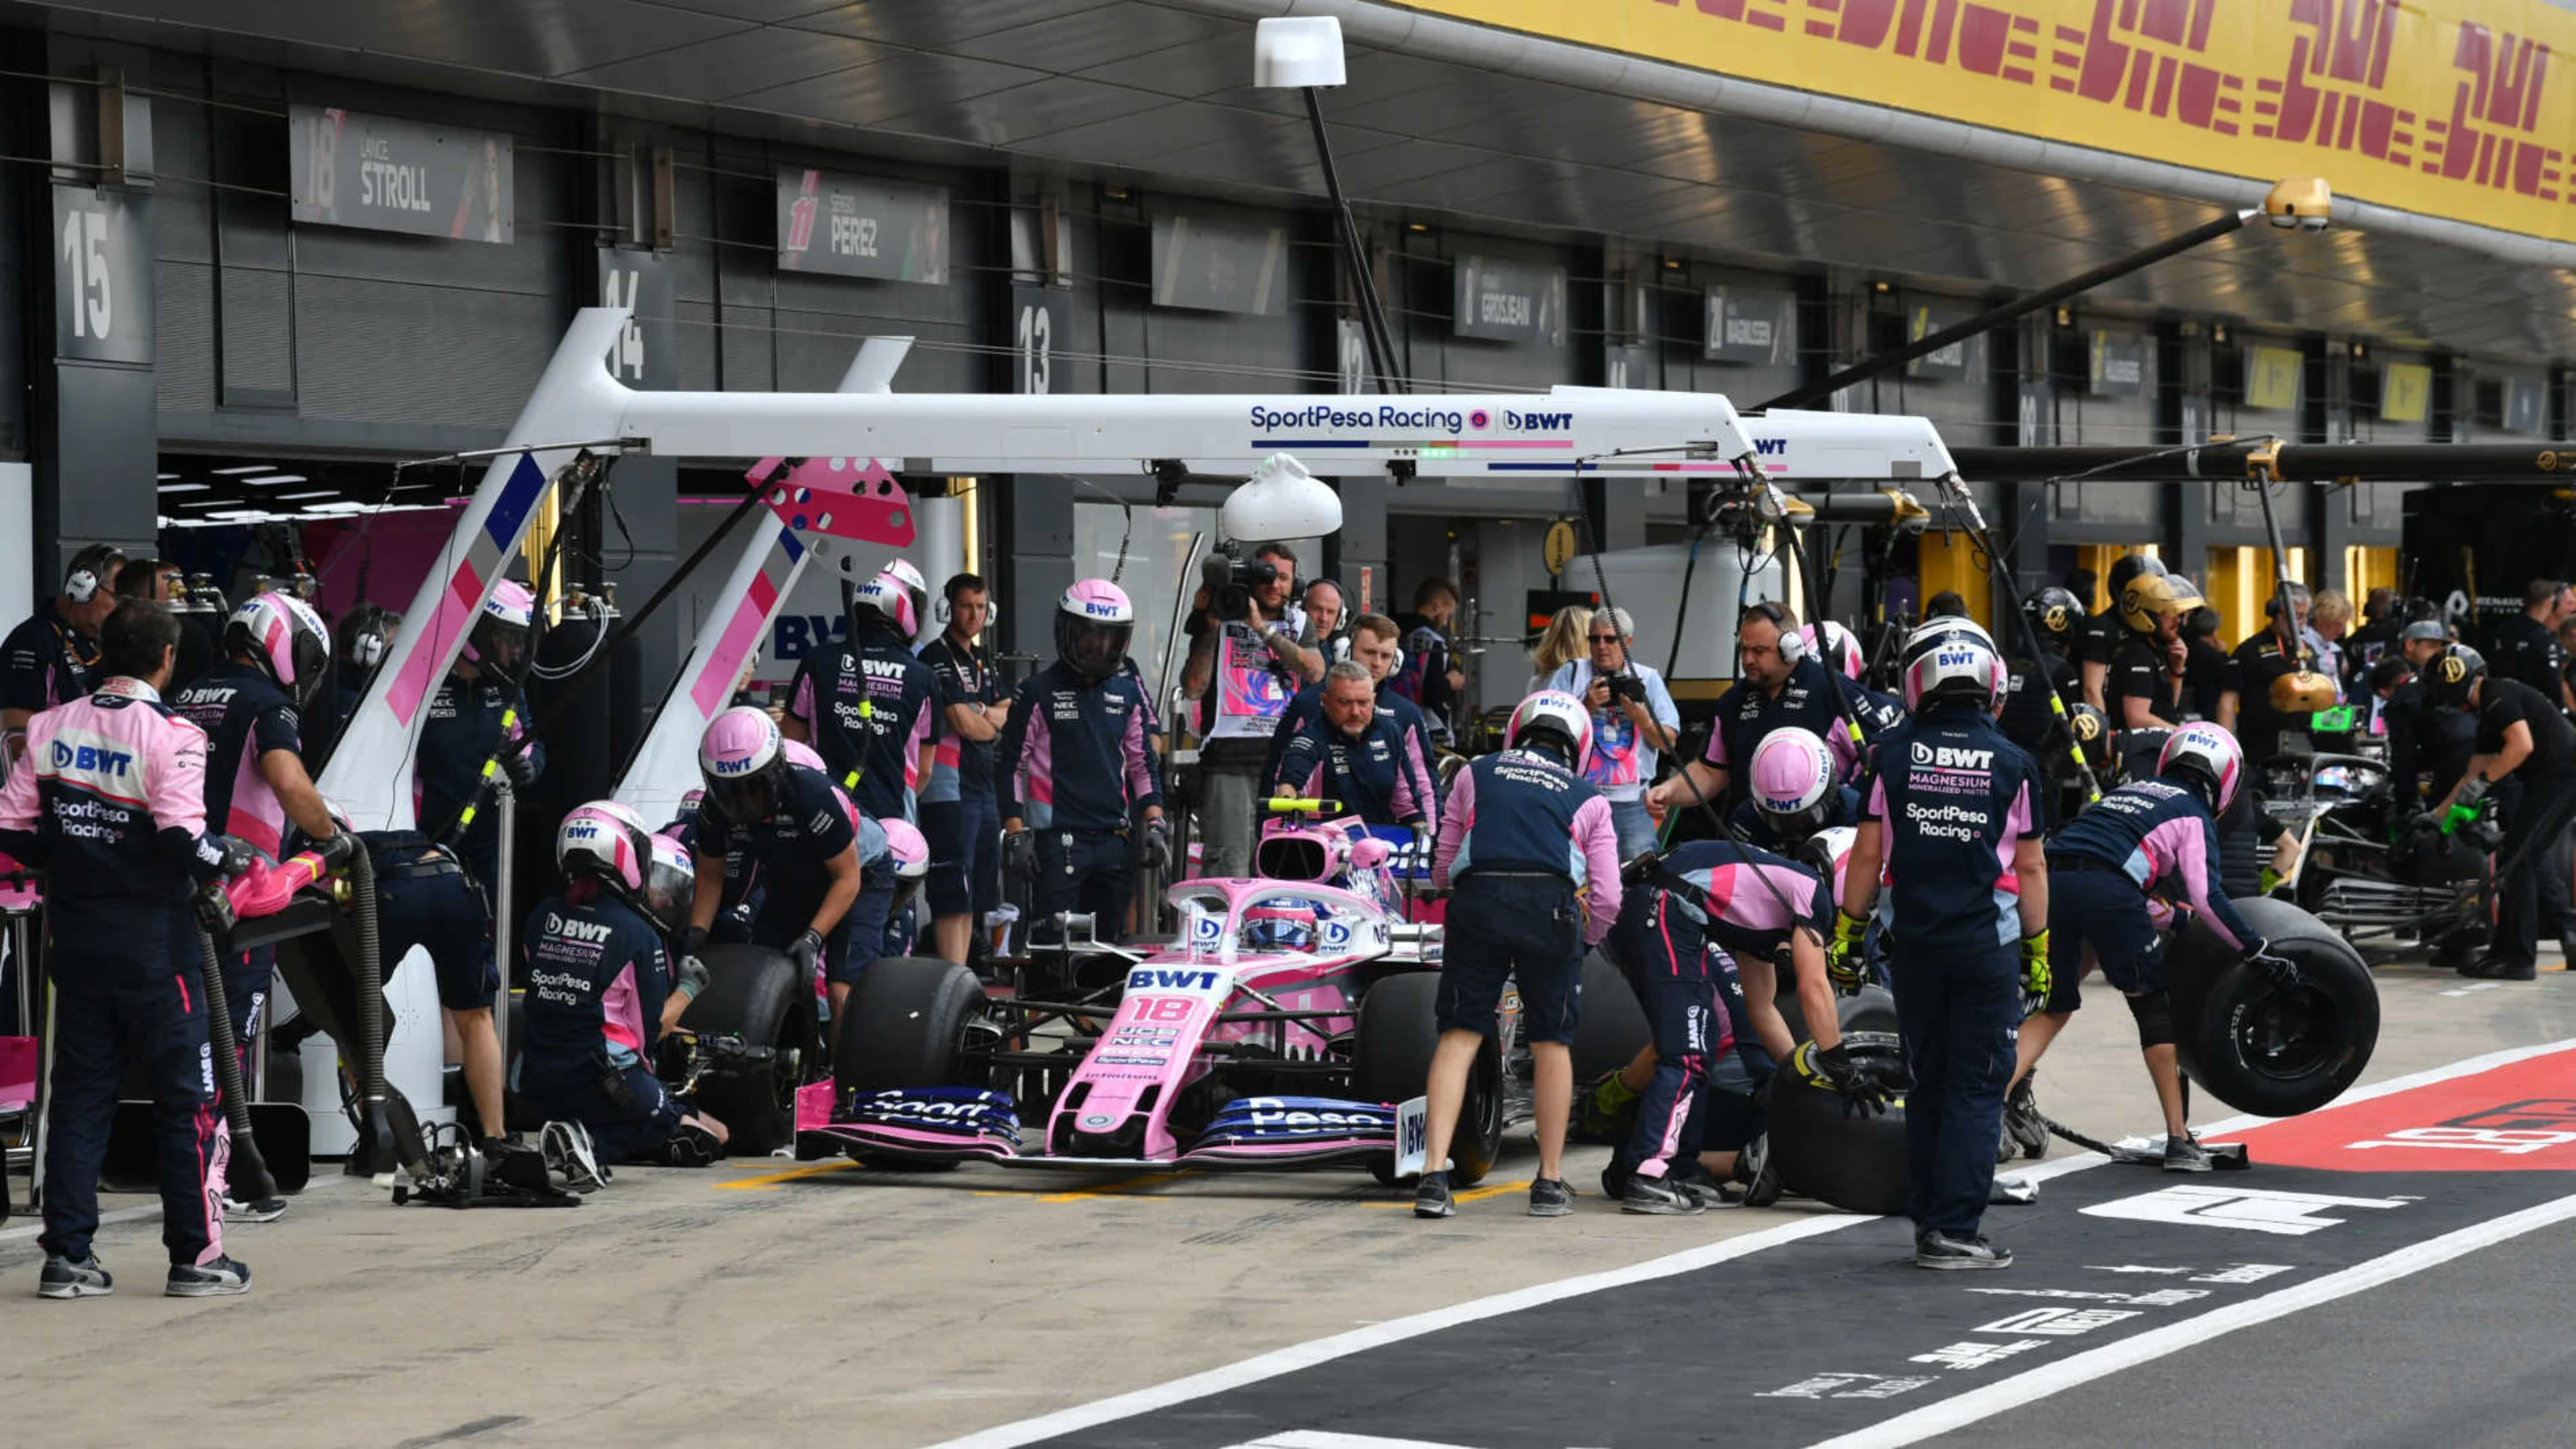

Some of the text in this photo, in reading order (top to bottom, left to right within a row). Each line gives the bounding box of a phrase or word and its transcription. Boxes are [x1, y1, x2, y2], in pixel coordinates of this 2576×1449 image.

[2442, 20, 2550, 196] DHL
[361, 162, 431, 212] STROLL
[831, 214, 878, 257] PEREZ
[64, 211, 111, 340] 15
[1019, 305, 1050, 394] 13
[1251, 405, 1462, 433] SportPesa Racing
[1525, 412, 1573, 429] BWT
[856, 584, 883, 597] BWT
[1085, 602, 1118, 617] BWT
[862, 658, 907, 679] BWT
[1939, 652, 1974, 667] BWT
[192, 687, 238, 705] BWT
[1054, 701, 1078, 709] NEC
[1539, 697, 1573, 711] BWT
[2186, 733, 2219, 749] BWT
[75, 745, 132, 778] BWT
[716, 757, 752, 774] BWT
[1936, 746, 1994, 770] BWT
[1493, 766, 1569, 790] SportPesa
[1505, 774, 1554, 790] Racing
[1908, 771, 1991, 788] MAGNESIUM
[52, 796, 130, 824] SportPesa
[1907, 803, 1988, 824] SportPesa
[61, 818, 115, 844] Racing
[567, 827, 597, 839] BWT
[1920, 821, 1971, 842] Racing
[562, 919, 613, 943] BWT
[539, 942, 603, 960] MAGNESIUM
[531, 968, 591, 992] SportPesa
[1128, 971, 1220, 989] BWT
[537, 985, 577, 1005] Racing
[1131, 997, 1193, 1022] 18
[1111, 1037, 1175, 1047] NEC
[1096, 1056, 1166, 1066] SportPesa
[201, 1058, 215, 1092] BWT
[864, 1090, 993, 1128] Sport
[1250, 1096, 1383, 1134] Pesa
